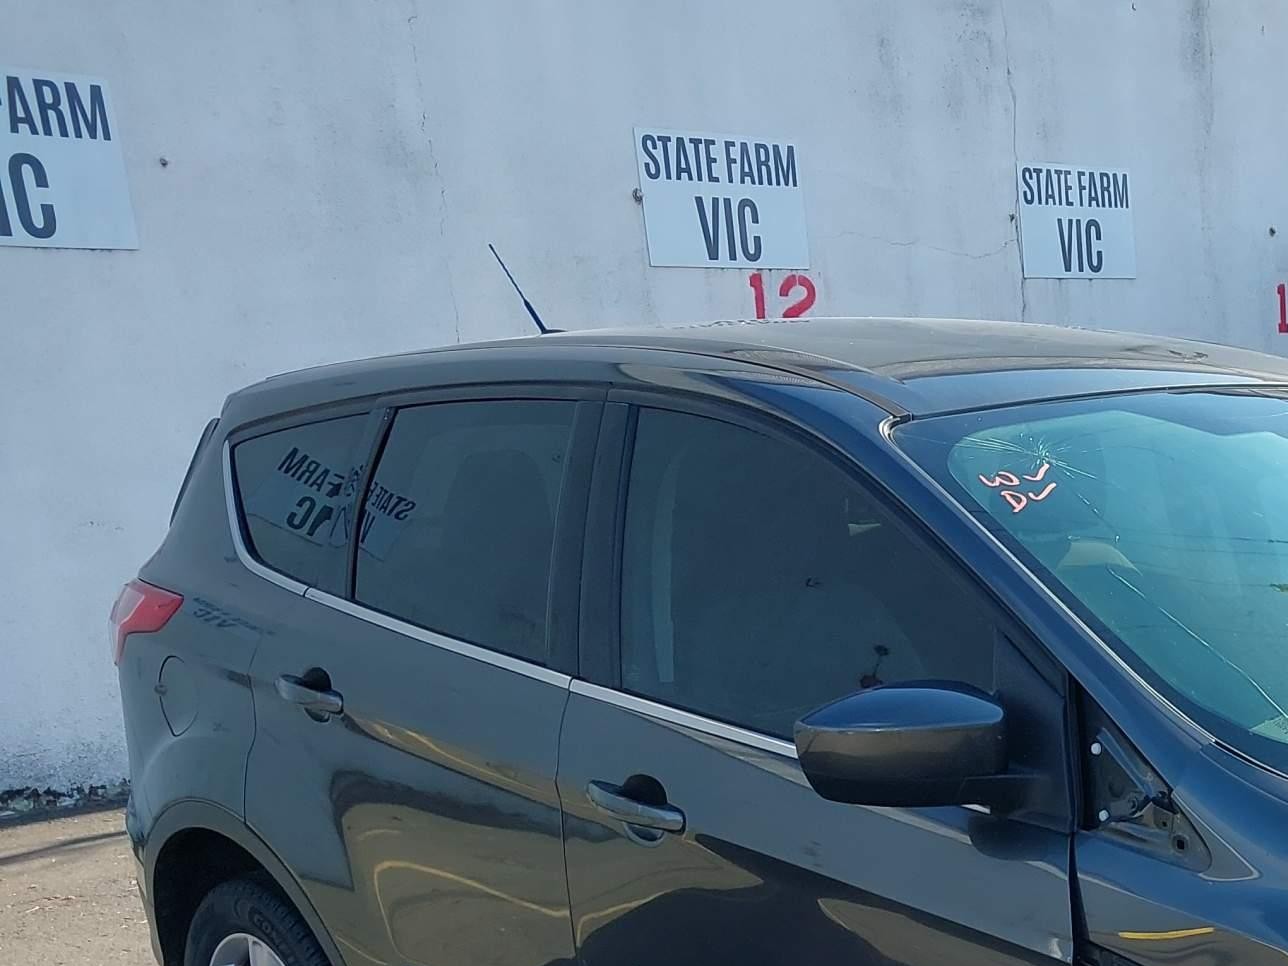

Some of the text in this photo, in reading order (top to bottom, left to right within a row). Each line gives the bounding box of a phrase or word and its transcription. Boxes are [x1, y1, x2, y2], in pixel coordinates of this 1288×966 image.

[0, 75, 112, 141] ARM
[641, 134, 798, 188] STATE FARM
[1021, 167, 1130, 209] STATE FARM
[694, 196, 762, 262] VIC
[1057, 218, 1104, 273] VIC
[749, 272, 817, 320] 12
